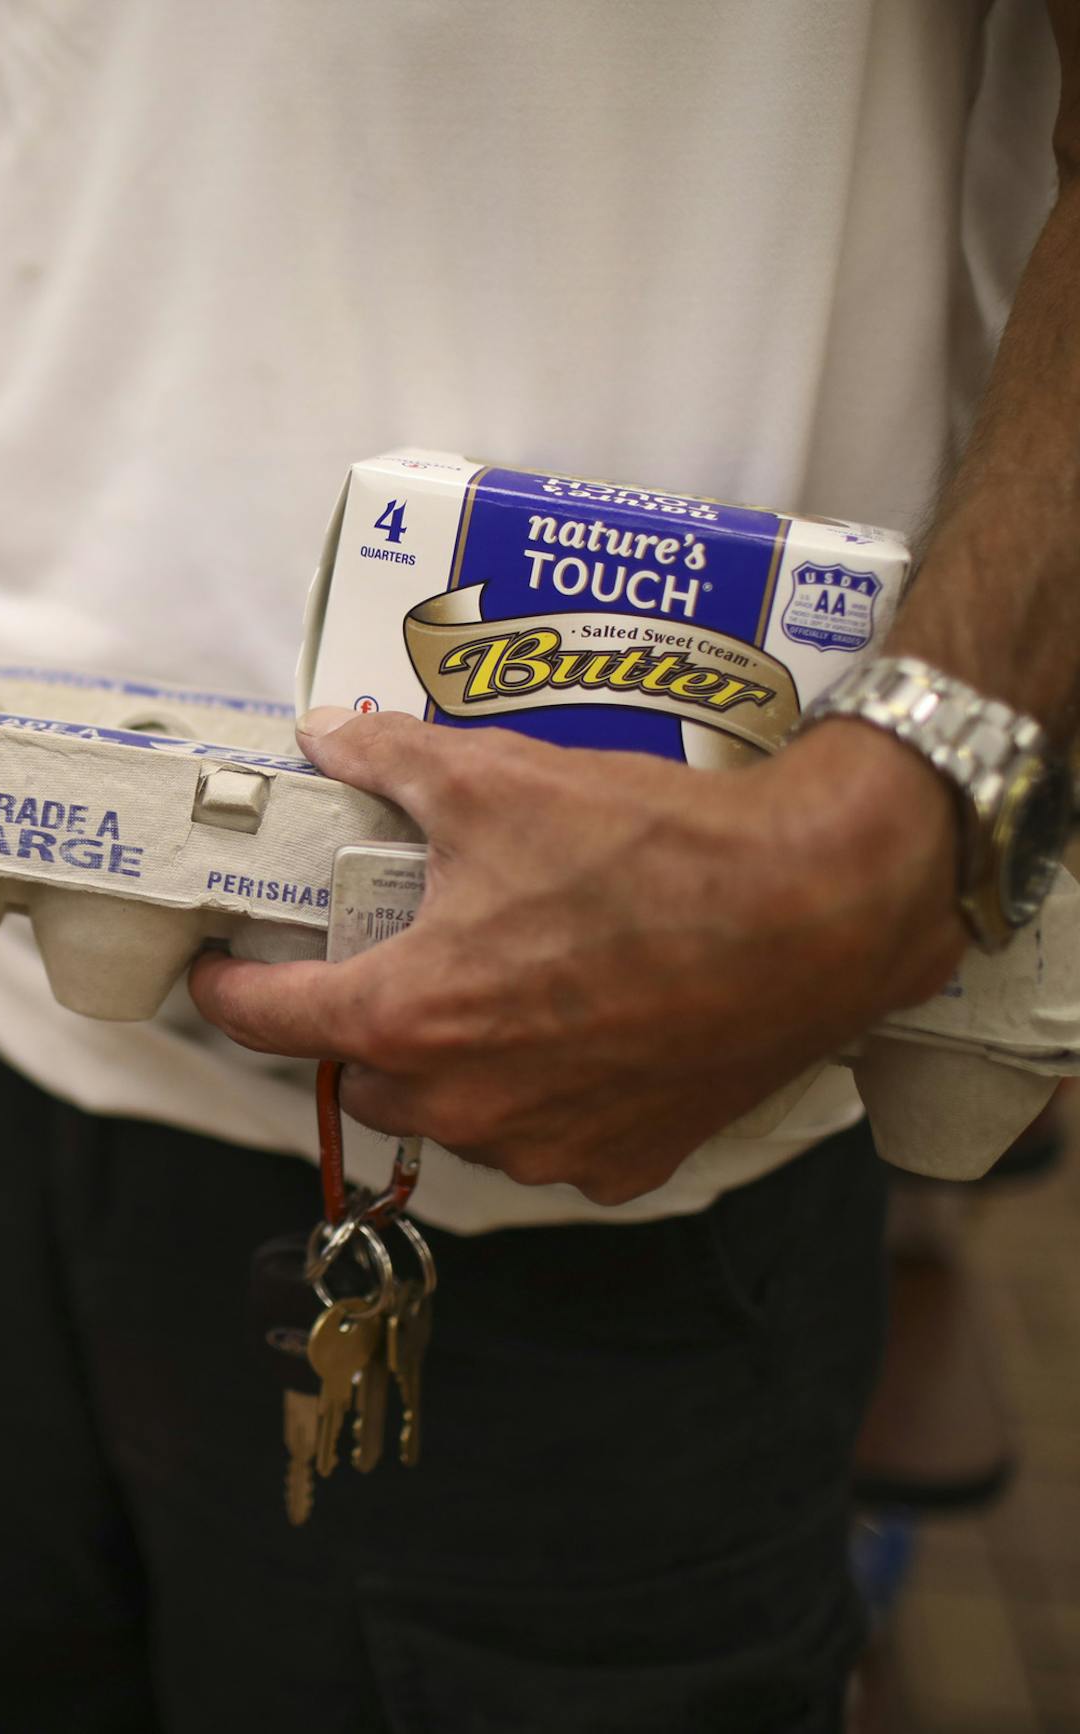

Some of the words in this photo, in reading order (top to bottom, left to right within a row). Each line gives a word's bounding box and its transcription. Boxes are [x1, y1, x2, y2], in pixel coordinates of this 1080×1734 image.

[374, 499, 408, 544] 4
[360, 545, 416, 566] QUARTERS
[528, 515, 707, 570] nature's
[805, 571, 869, 593] USDA
[814, 589, 845, 617] AA
[581, 625, 638, 640] Salted
[642, 628, 694, 649] Sweet
[697, 640, 750, 667] Cream
[438, 626, 776, 711] Butter
[96, 810, 120, 841] A
[376, 907, 414, 922] 5788
